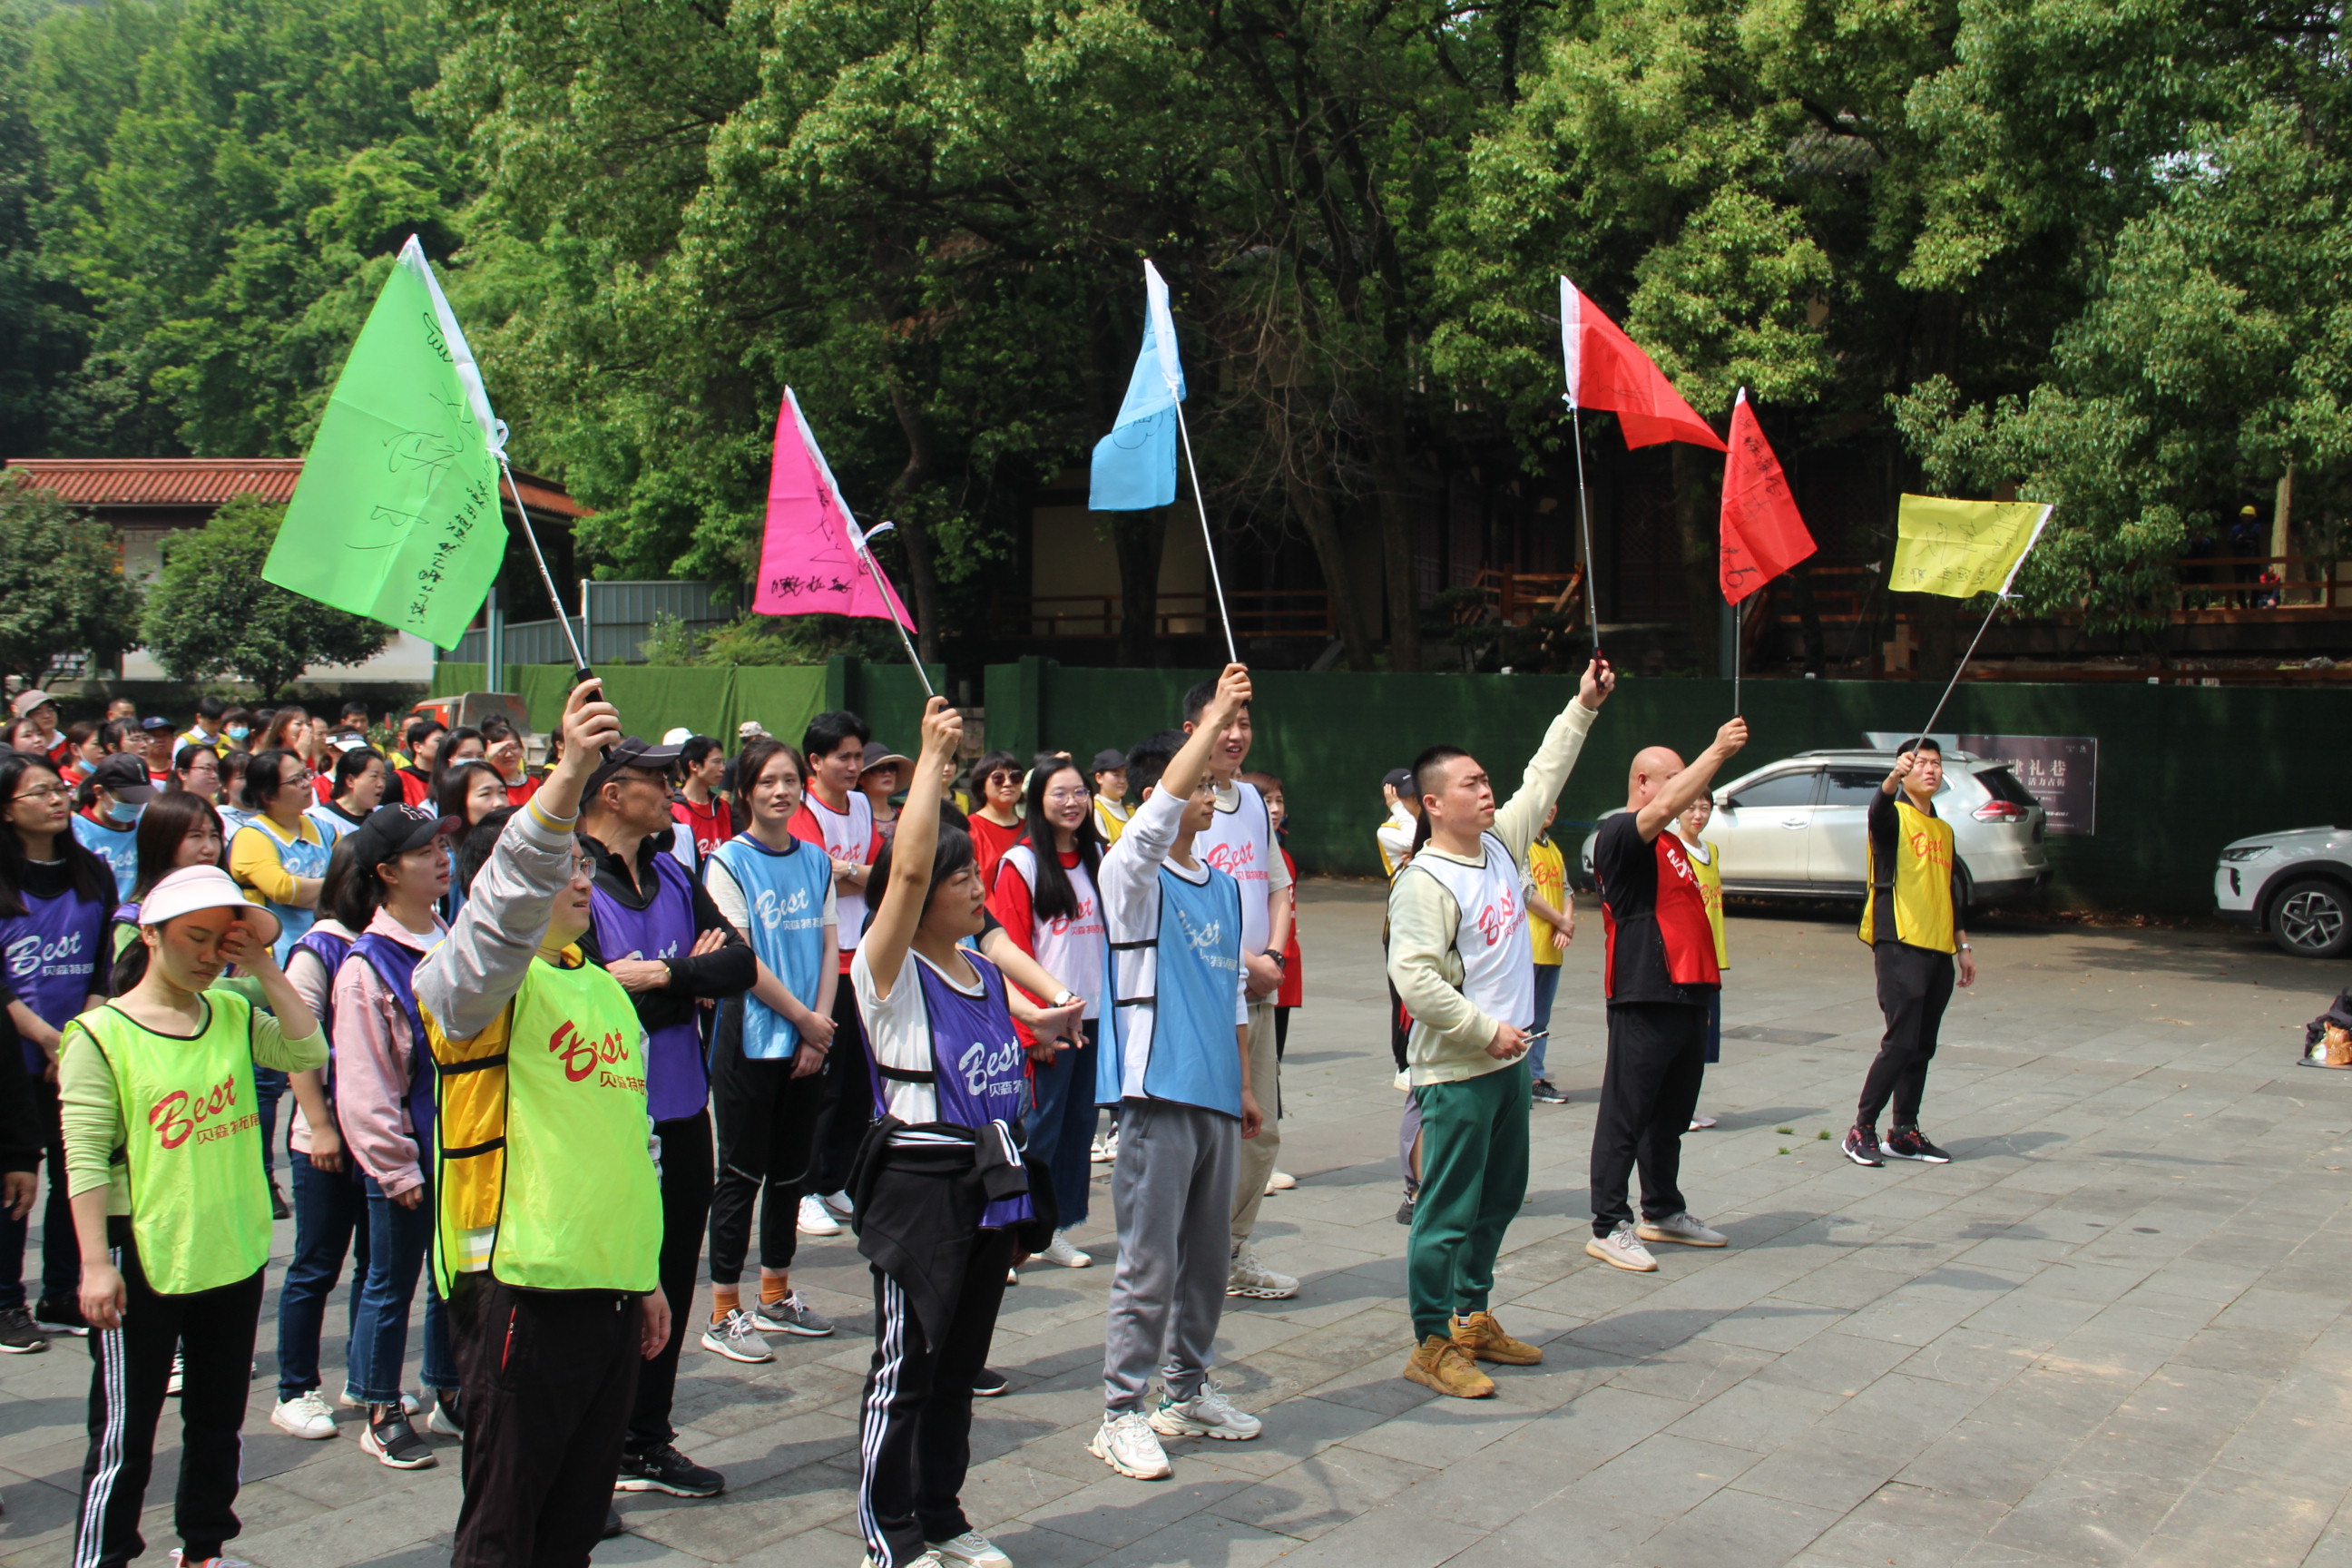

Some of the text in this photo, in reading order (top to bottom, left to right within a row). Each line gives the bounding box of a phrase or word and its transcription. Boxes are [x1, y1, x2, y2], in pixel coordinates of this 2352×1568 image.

[1207, 840, 1254, 874] Best
[1911, 832, 1944, 858] Best
[753, 887, 809, 929] Best
[1044, 897, 1093, 936] Bst
[5, 931, 82, 975] Best
[958, 1036, 1020, 1095] Best
[149, 1073, 236, 1149] Best
